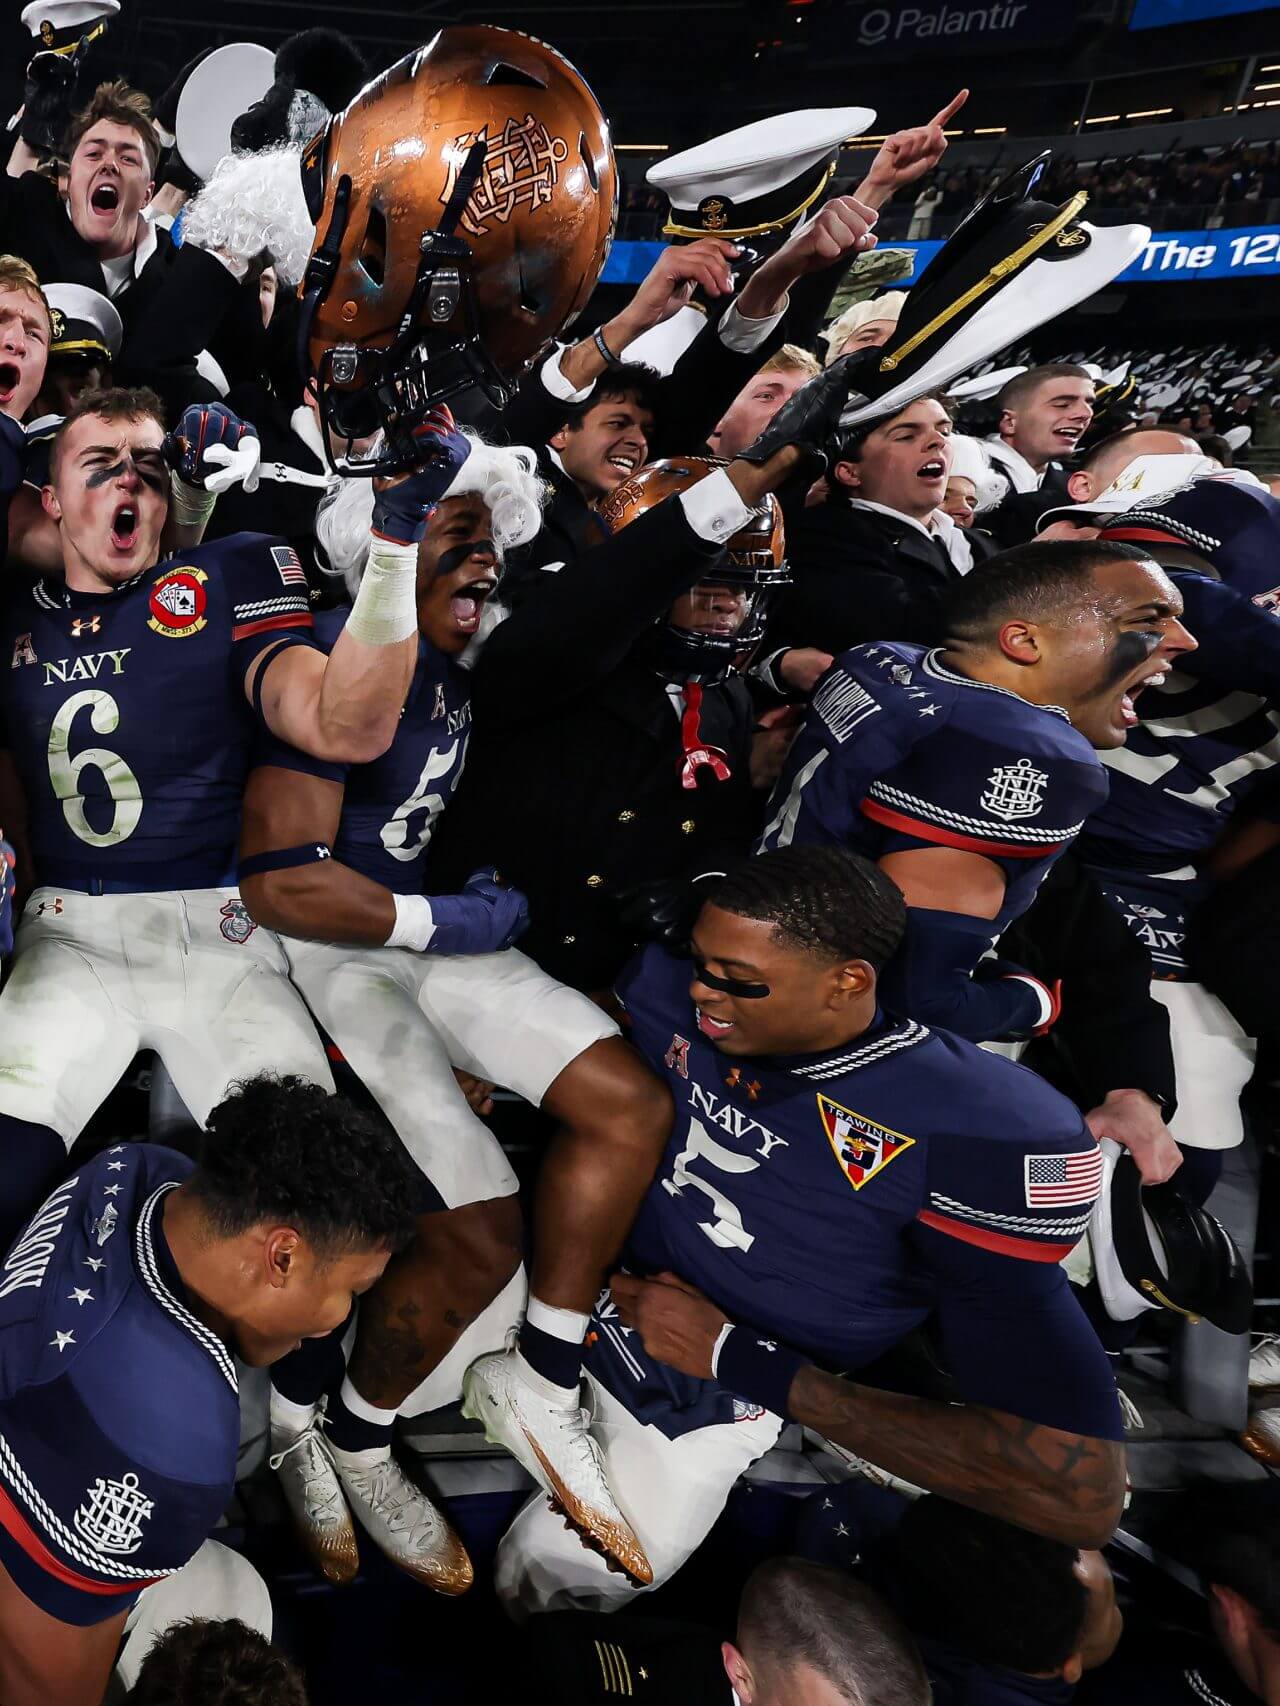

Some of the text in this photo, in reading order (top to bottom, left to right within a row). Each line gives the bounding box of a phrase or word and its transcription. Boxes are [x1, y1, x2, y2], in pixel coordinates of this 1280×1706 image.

[895, 0, 1027, 39] Palantir
[1141, 234, 1280, 271] The 12
[42, 648, 132, 686] NAVY
[47, 689, 144, 848] 6
[687, 1081, 790, 1159] NAVY
[827, 1104, 896, 1144] TRAWING
[661, 1116, 762, 1253] 5
